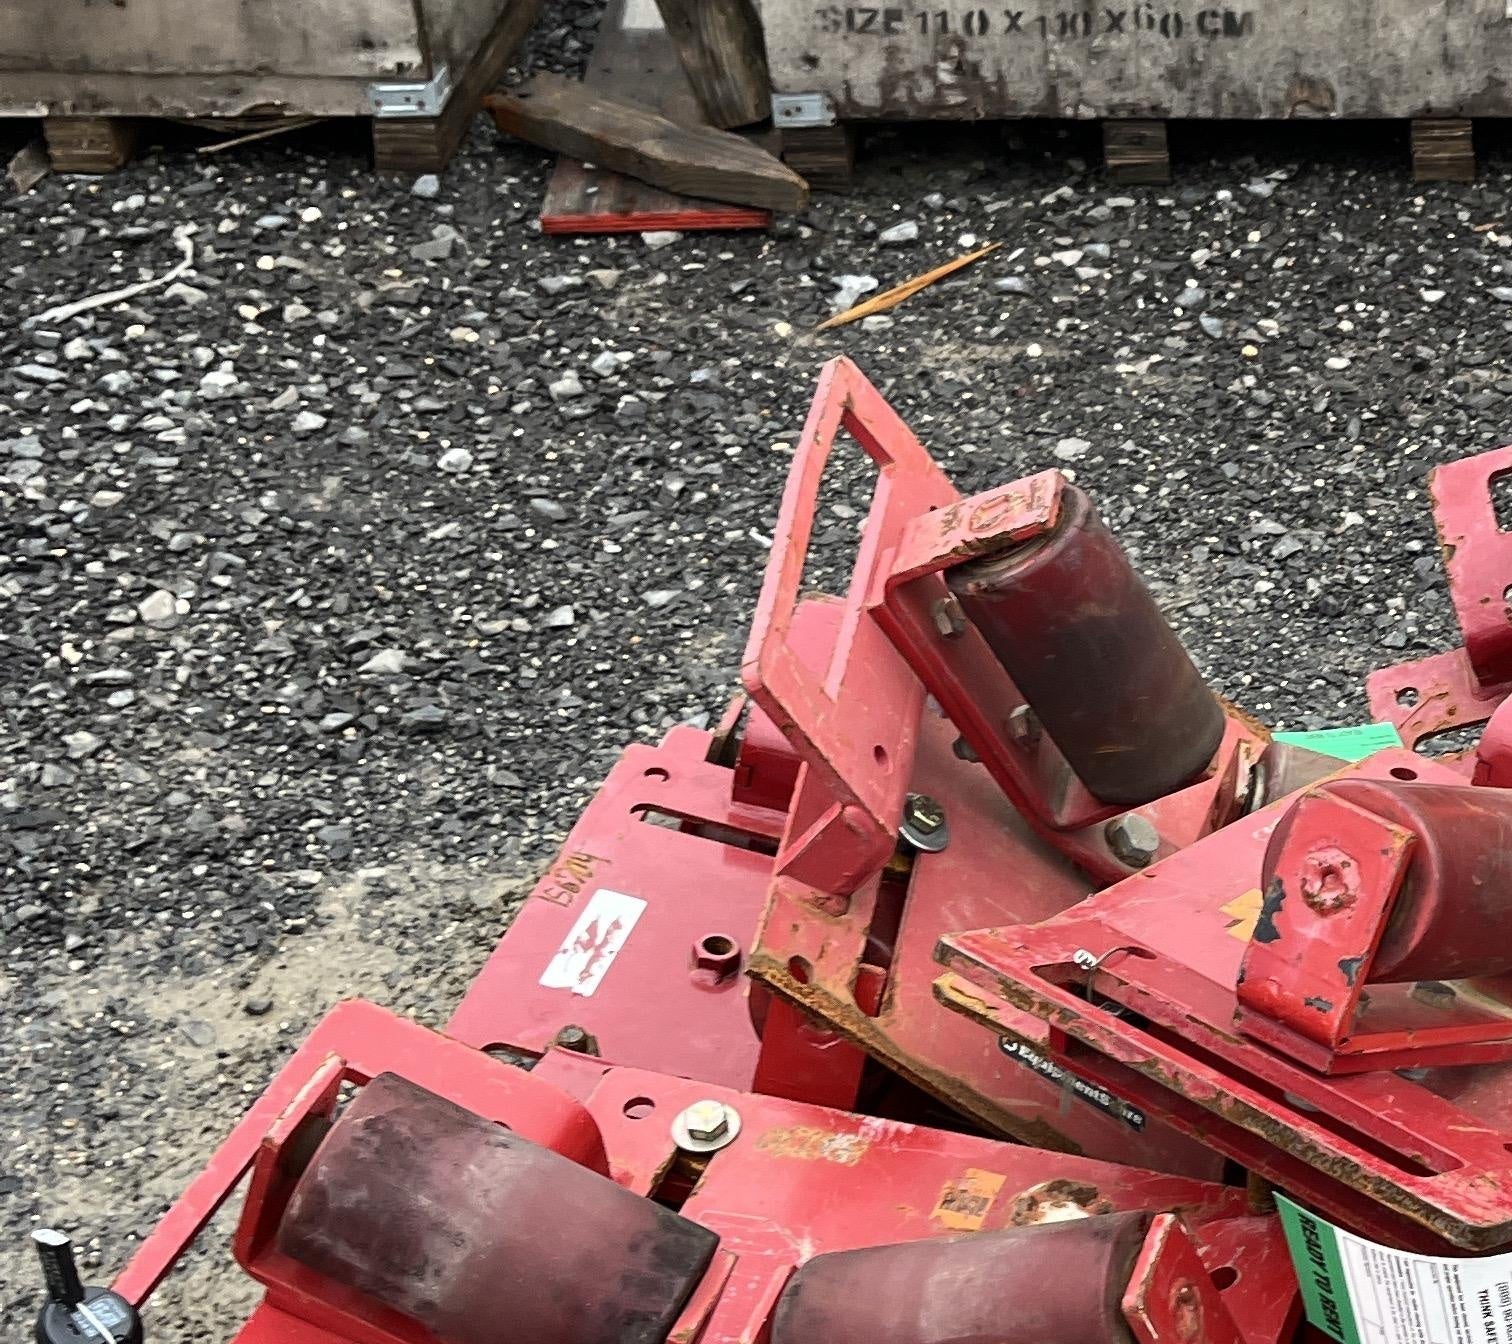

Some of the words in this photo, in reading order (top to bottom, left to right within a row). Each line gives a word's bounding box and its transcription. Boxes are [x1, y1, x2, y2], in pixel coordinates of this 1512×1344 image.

[814, 7, 902, 35] SIZE
[1298, 1212, 1328, 1273] READY
[1318, 1292, 1345, 1340] RENT
[1478, 1289, 1494, 1318] THINK
